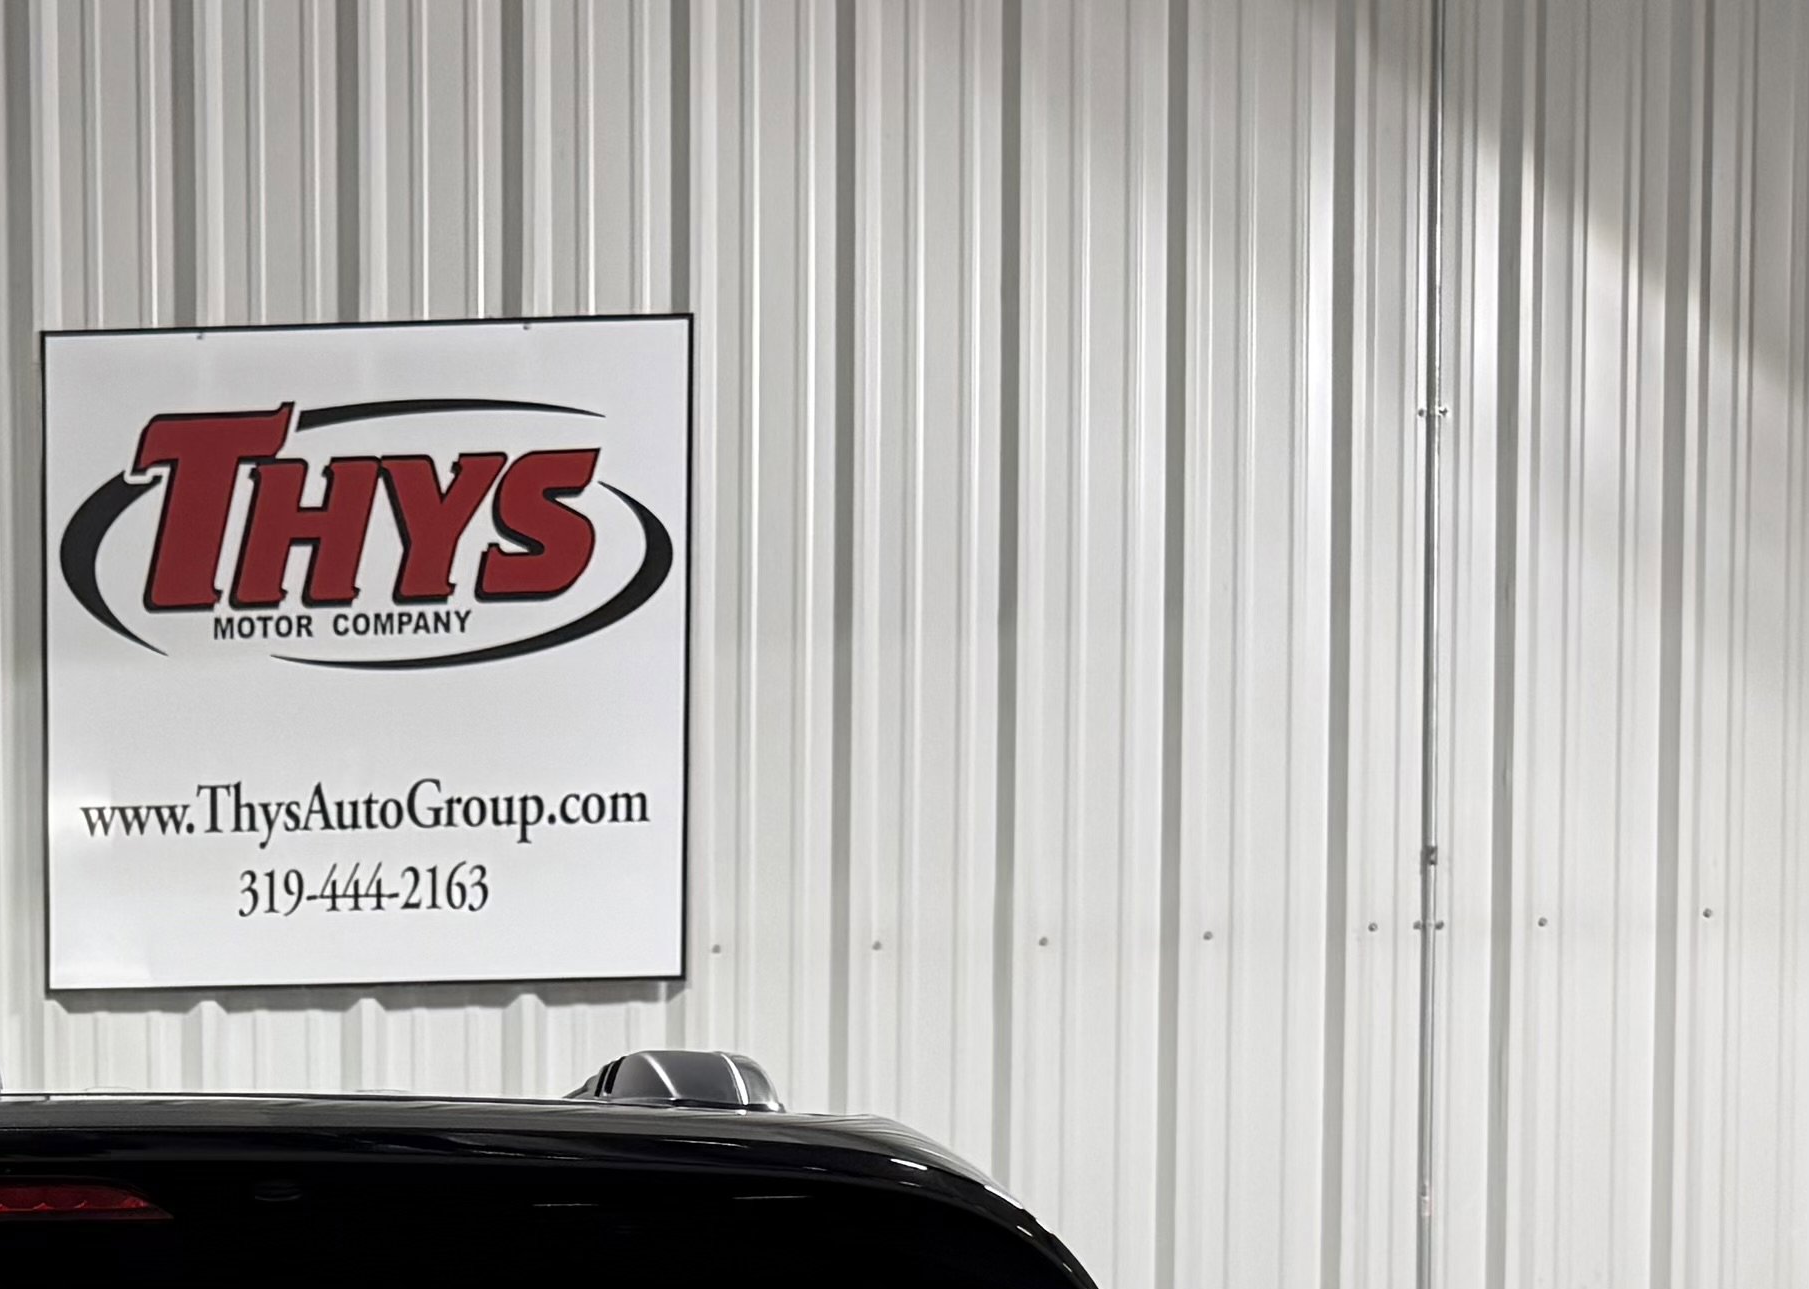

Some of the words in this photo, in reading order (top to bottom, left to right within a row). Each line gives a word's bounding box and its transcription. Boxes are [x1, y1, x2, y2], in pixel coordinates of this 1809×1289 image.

[132, 401, 601, 612] THYS
[213, 613, 314, 640] MOTOR
[332, 609, 472, 638] COMPANY
[80, 779, 650, 848] www.ThysAutoGroup.com
[238, 860, 489, 917] 319-444-2163
